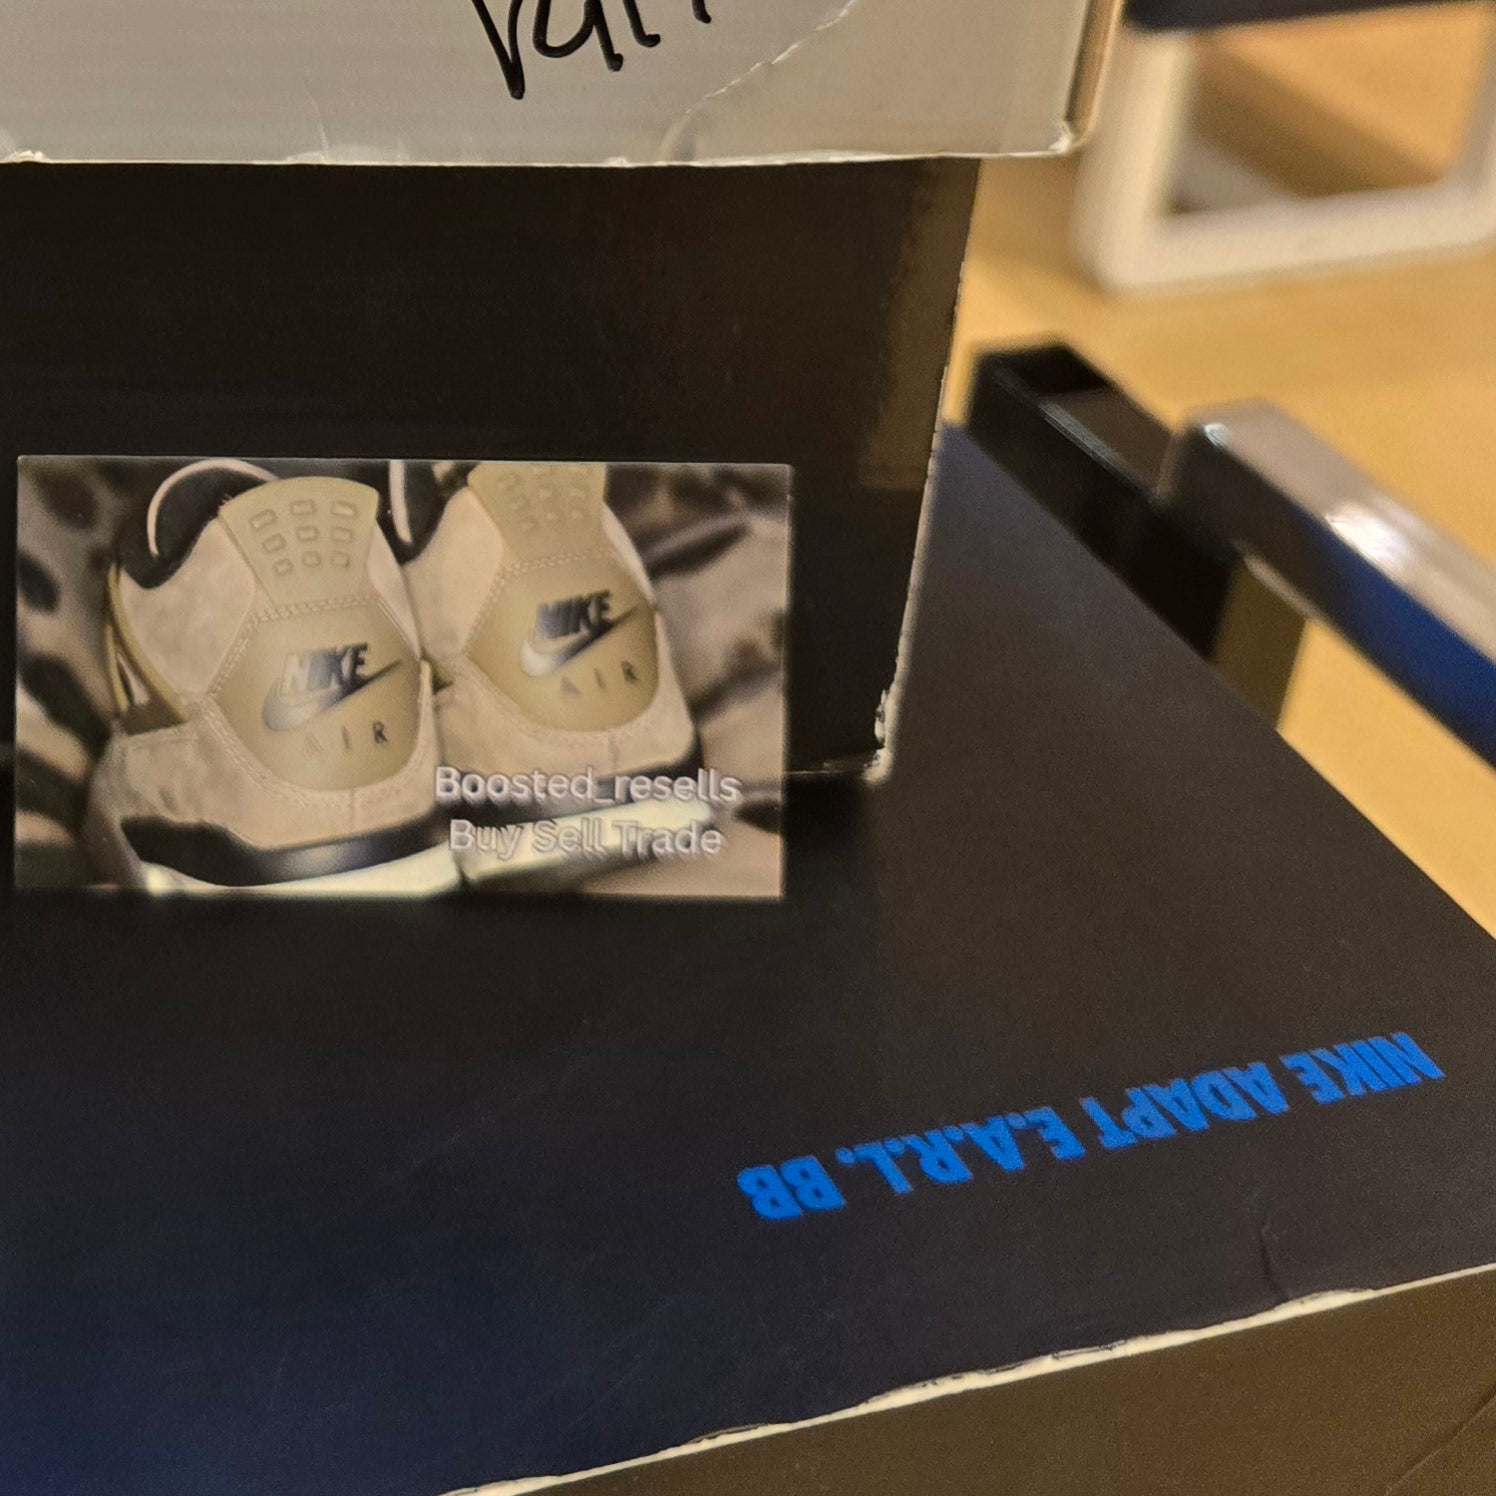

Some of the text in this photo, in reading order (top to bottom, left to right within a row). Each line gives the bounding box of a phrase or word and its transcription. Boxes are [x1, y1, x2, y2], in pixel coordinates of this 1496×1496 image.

[535, 589, 611, 638] NIKE
[278, 642, 368, 694] NIKE
[434, 765, 742, 804] Boosted_resells
[448, 816, 724, 861] Buy Sell Trade
[736, 1031, 1445, 1221] NIKE ADAPT E.A.R.L. BB
